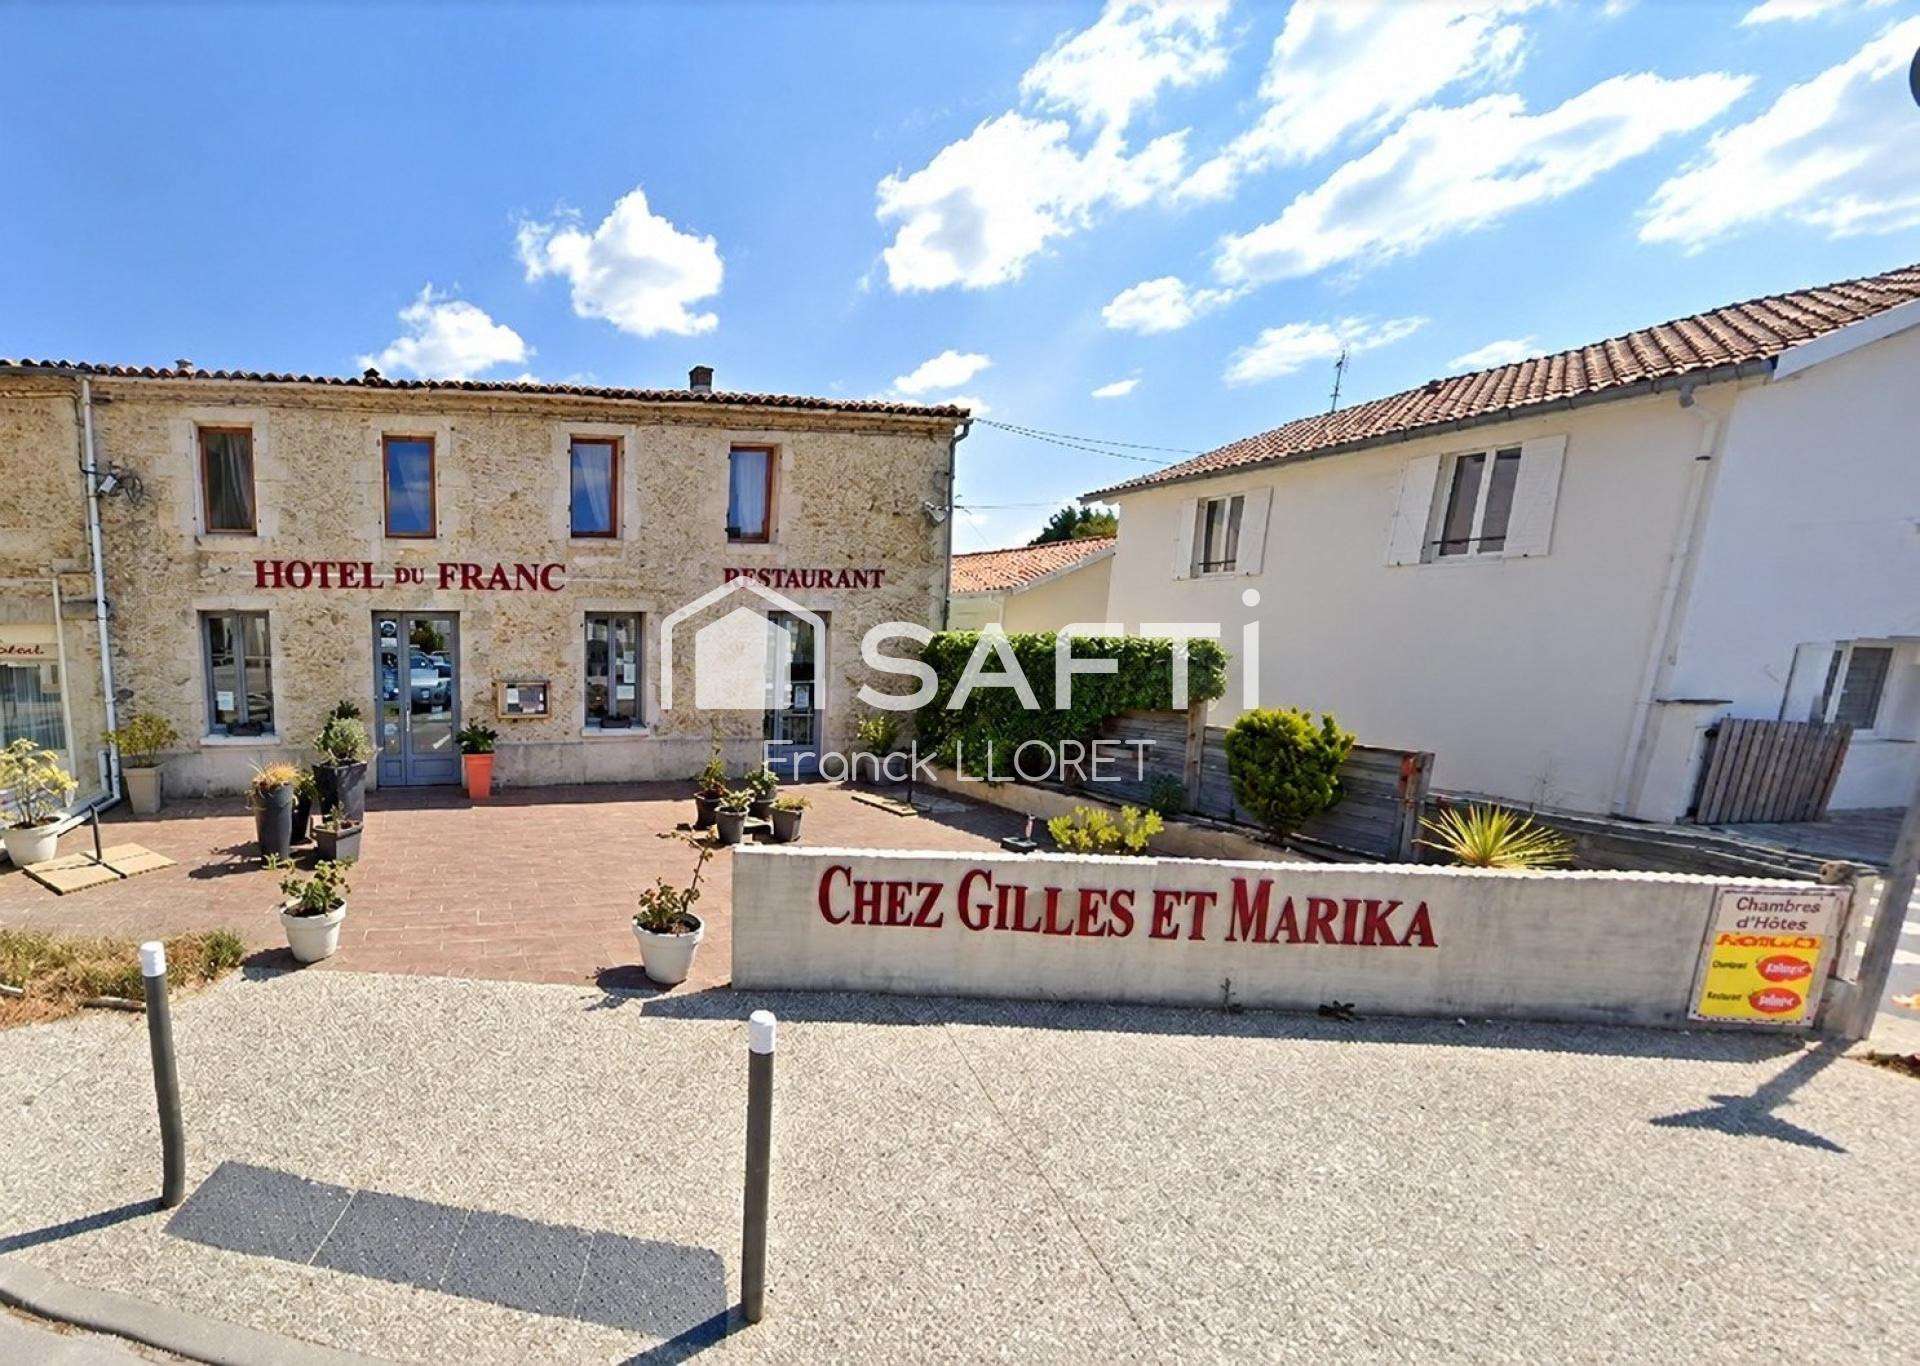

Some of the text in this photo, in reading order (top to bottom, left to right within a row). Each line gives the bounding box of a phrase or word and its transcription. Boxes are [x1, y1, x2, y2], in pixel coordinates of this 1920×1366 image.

[254, 560, 566, 592] HOTEL DU FRANC
[819, 865, 1438, 947] CHEZ GILLES ET MARIKA
[1736, 896, 1821, 914] Chambres
[1736, 916, 1808, 931] d'Hôtes
